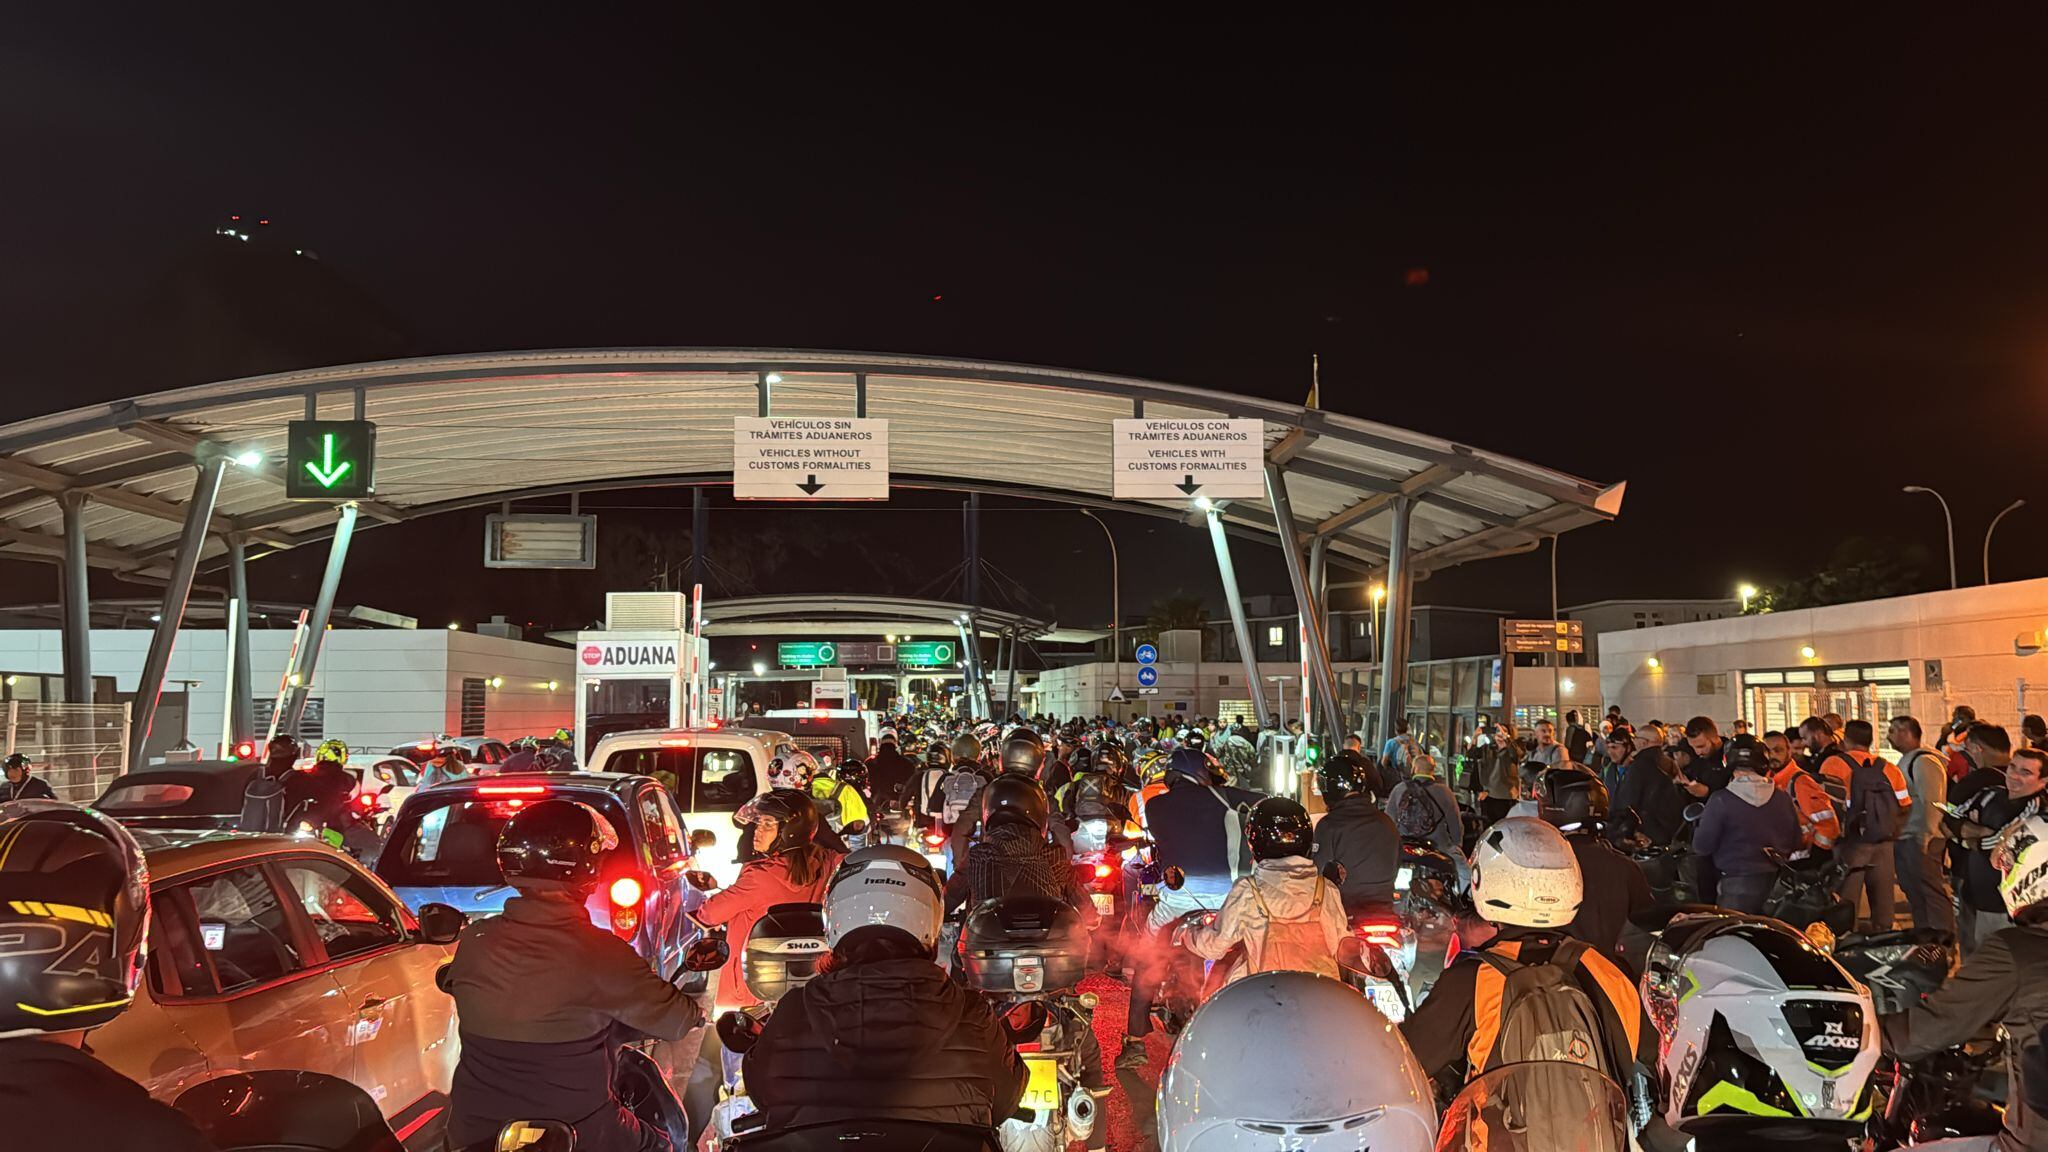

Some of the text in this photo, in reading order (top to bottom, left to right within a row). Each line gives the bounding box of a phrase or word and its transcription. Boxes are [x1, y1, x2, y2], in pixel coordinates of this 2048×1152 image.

[770, 419, 852, 430] VEHÍCULOS SIN
[1145, 421, 1230, 430] VEHÍCULOS CON
[750, 430, 873, 440] TRÁMITES ADUANEROS
[1128, 431, 1248, 441] TRÁMITES ADUANEROS
[759, 449, 861, 458] VEHICLES WITHOUT
[1148, 449, 1226, 458] VEHICLES WITH
[748, 461, 872, 470] CUSTOMS FORMALITIES
[1128, 462, 1247, 471] CUSTOMS FORMALITIES
[602, 646, 676, 666] ADUANA
[864, 877, 906, 887] hebo
[1803, 1034, 1860, 1050] AXXIS
